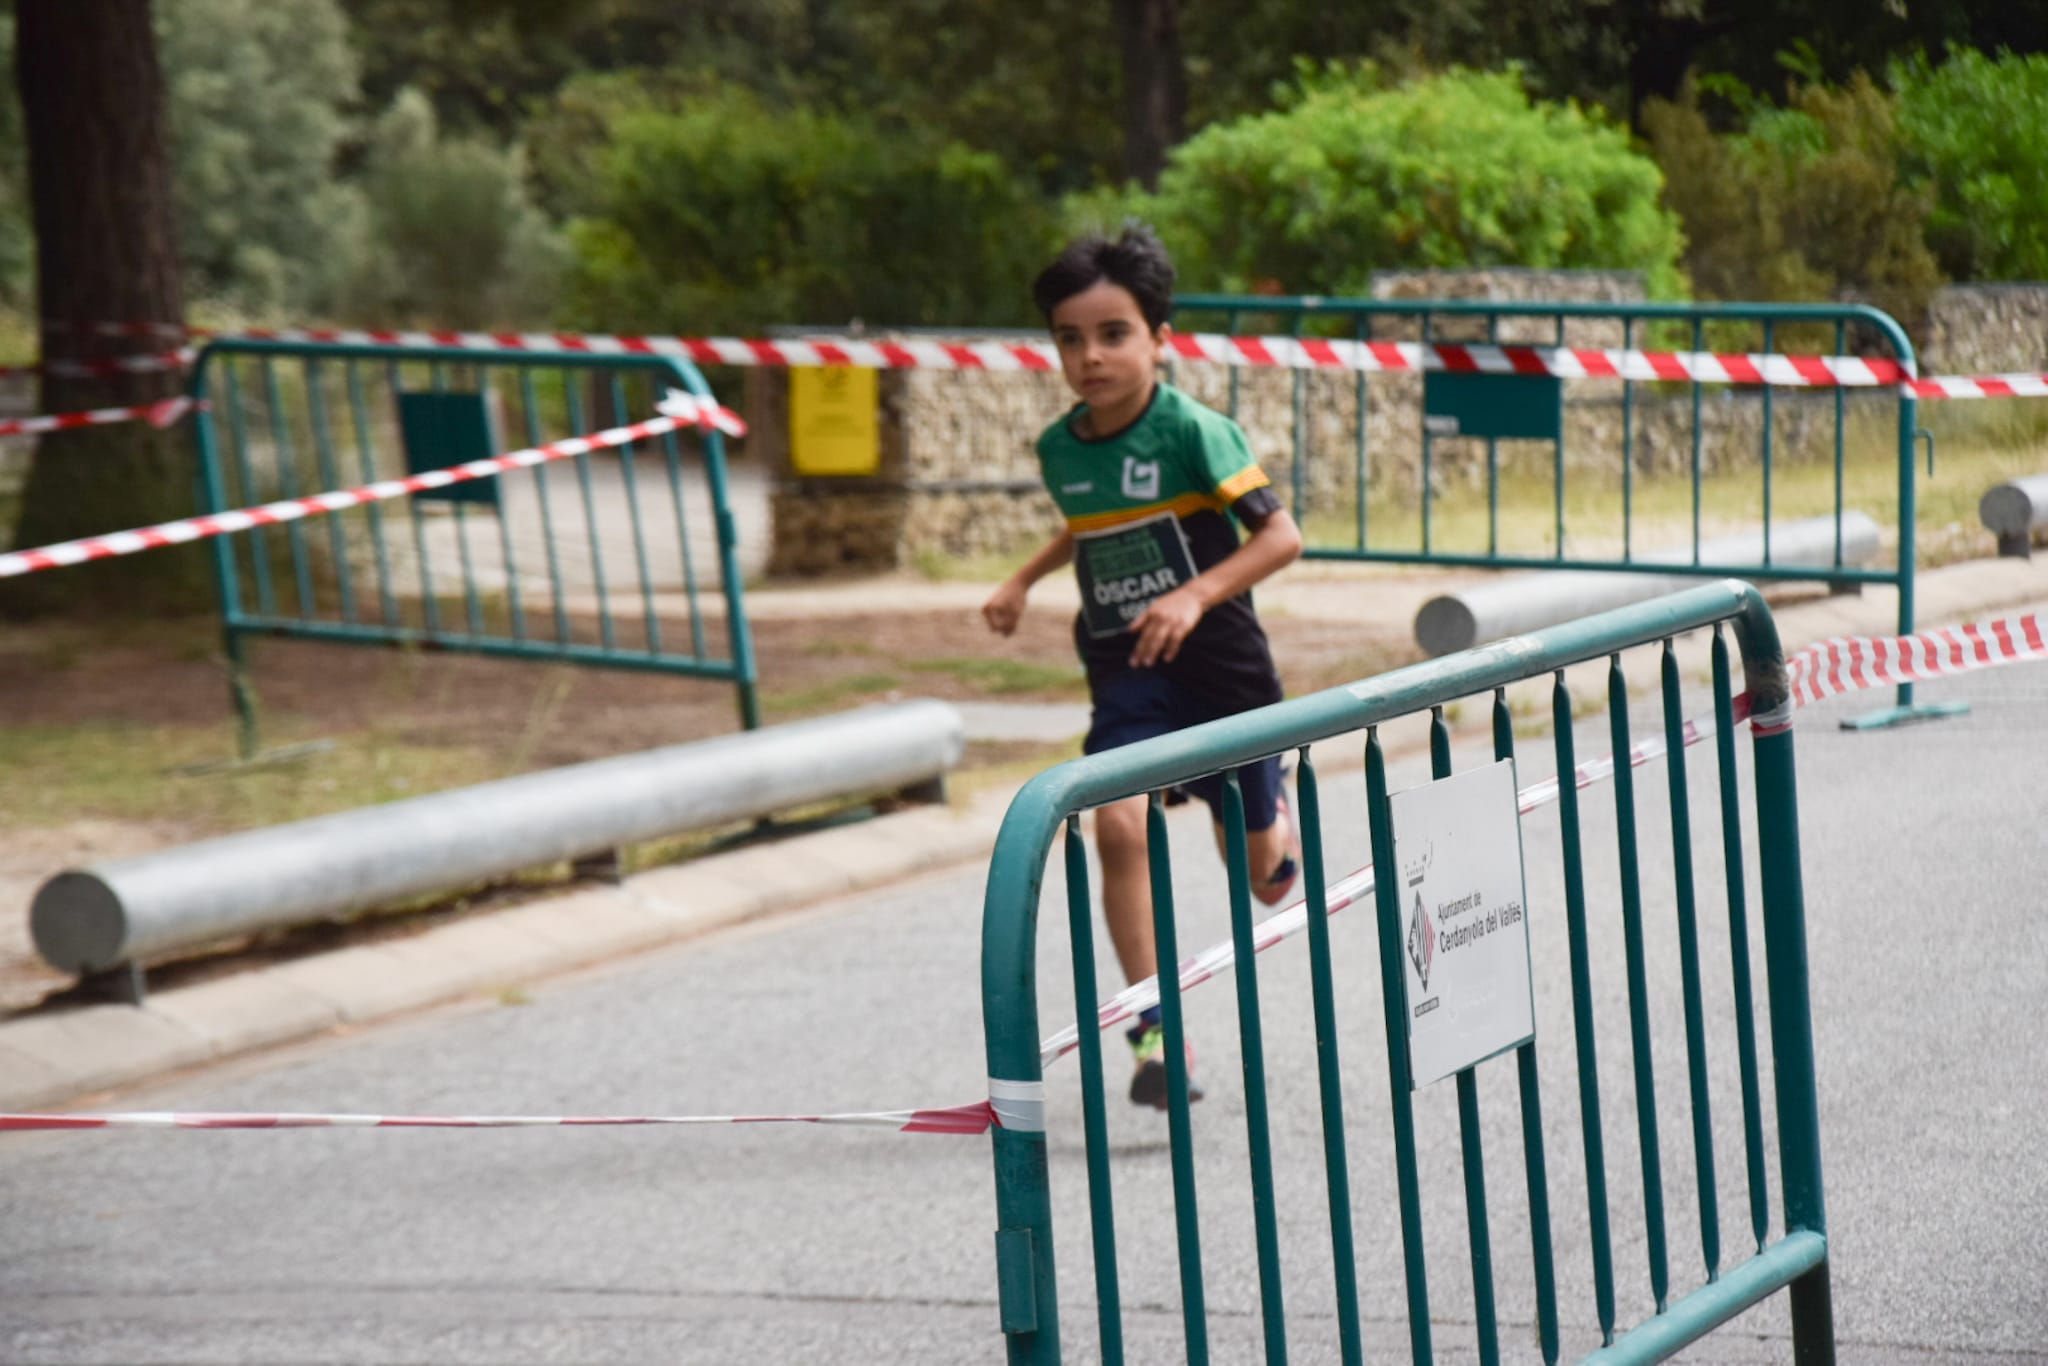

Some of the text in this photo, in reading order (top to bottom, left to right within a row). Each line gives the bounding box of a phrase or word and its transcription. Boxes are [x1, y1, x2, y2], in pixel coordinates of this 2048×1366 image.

[1438, 890, 1481, 924] Ajuntament de
[1440, 915, 1484, 953] Cerdanyola
[1486, 909, 1498, 934] del
